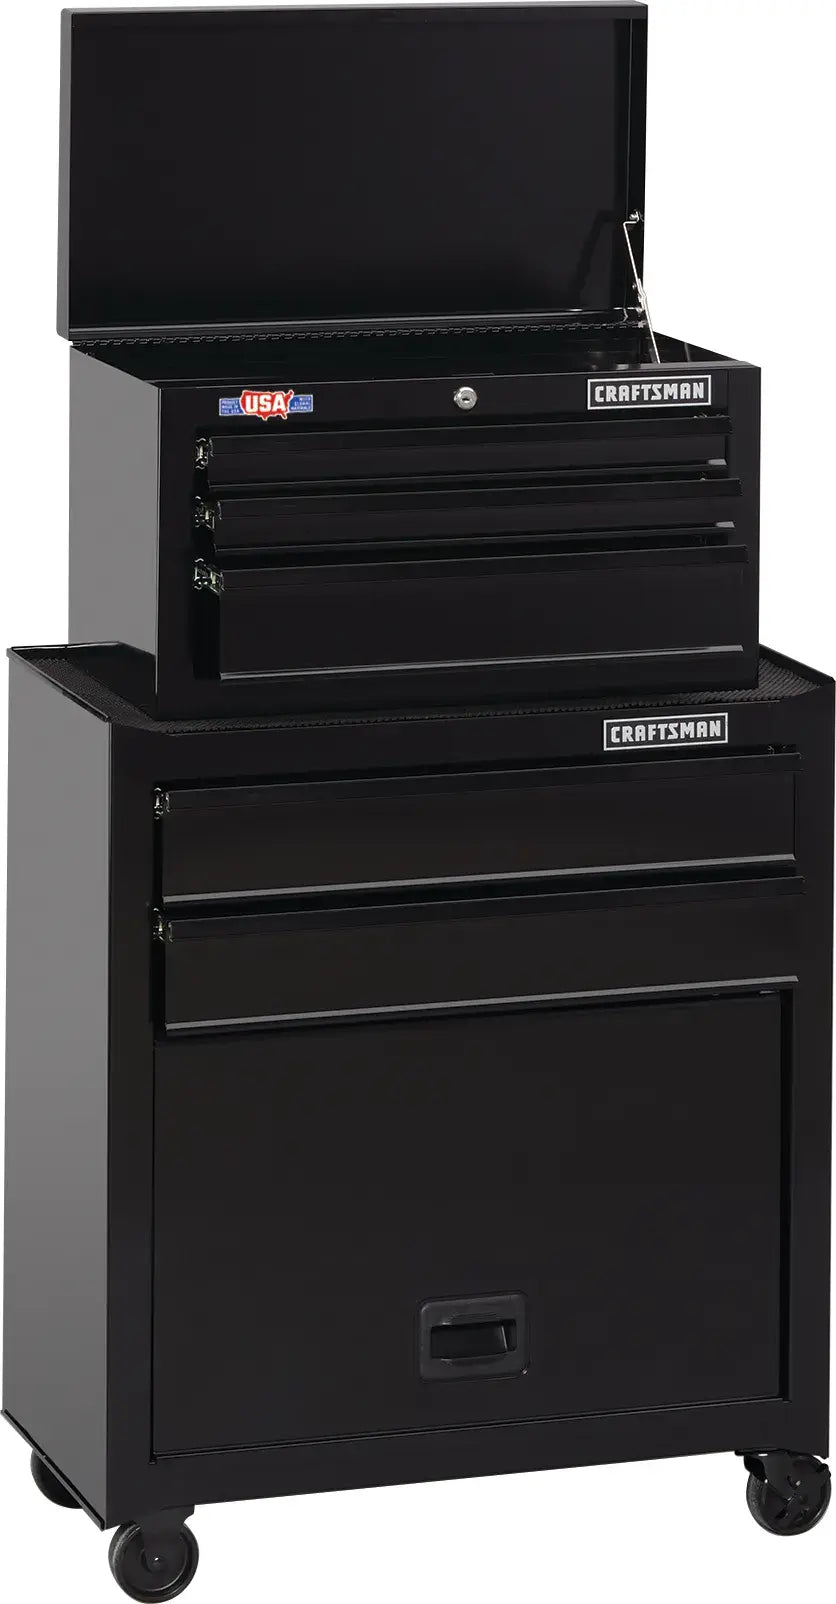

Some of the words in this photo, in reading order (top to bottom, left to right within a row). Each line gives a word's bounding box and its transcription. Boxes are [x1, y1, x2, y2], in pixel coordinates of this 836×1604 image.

[595, 382, 704, 402] CRAFTSMAN
[245, 394, 287, 412] USA
[611, 720, 721, 743] CRAFTSMAN
